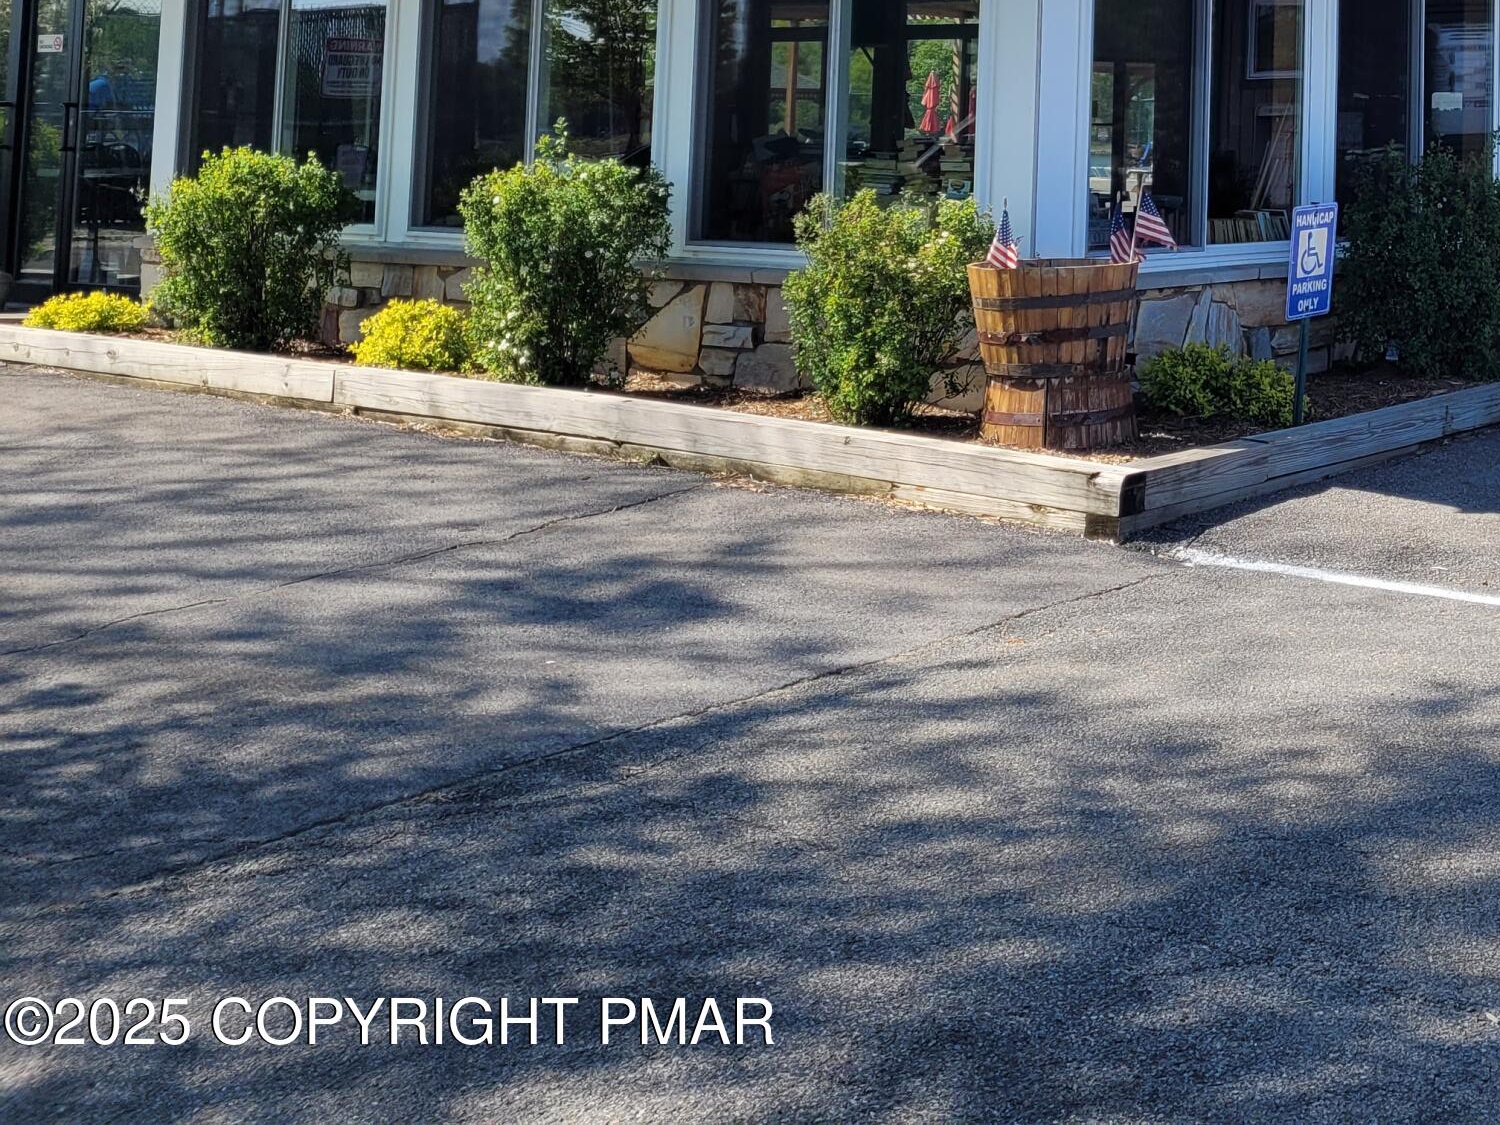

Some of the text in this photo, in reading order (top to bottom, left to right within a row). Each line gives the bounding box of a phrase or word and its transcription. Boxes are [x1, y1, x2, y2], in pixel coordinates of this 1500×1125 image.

[1296, 211, 1334, 227] HANDICAP
[1292, 279, 1328, 296] PARKING
[1298, 297, 1319, 312] ONLY
